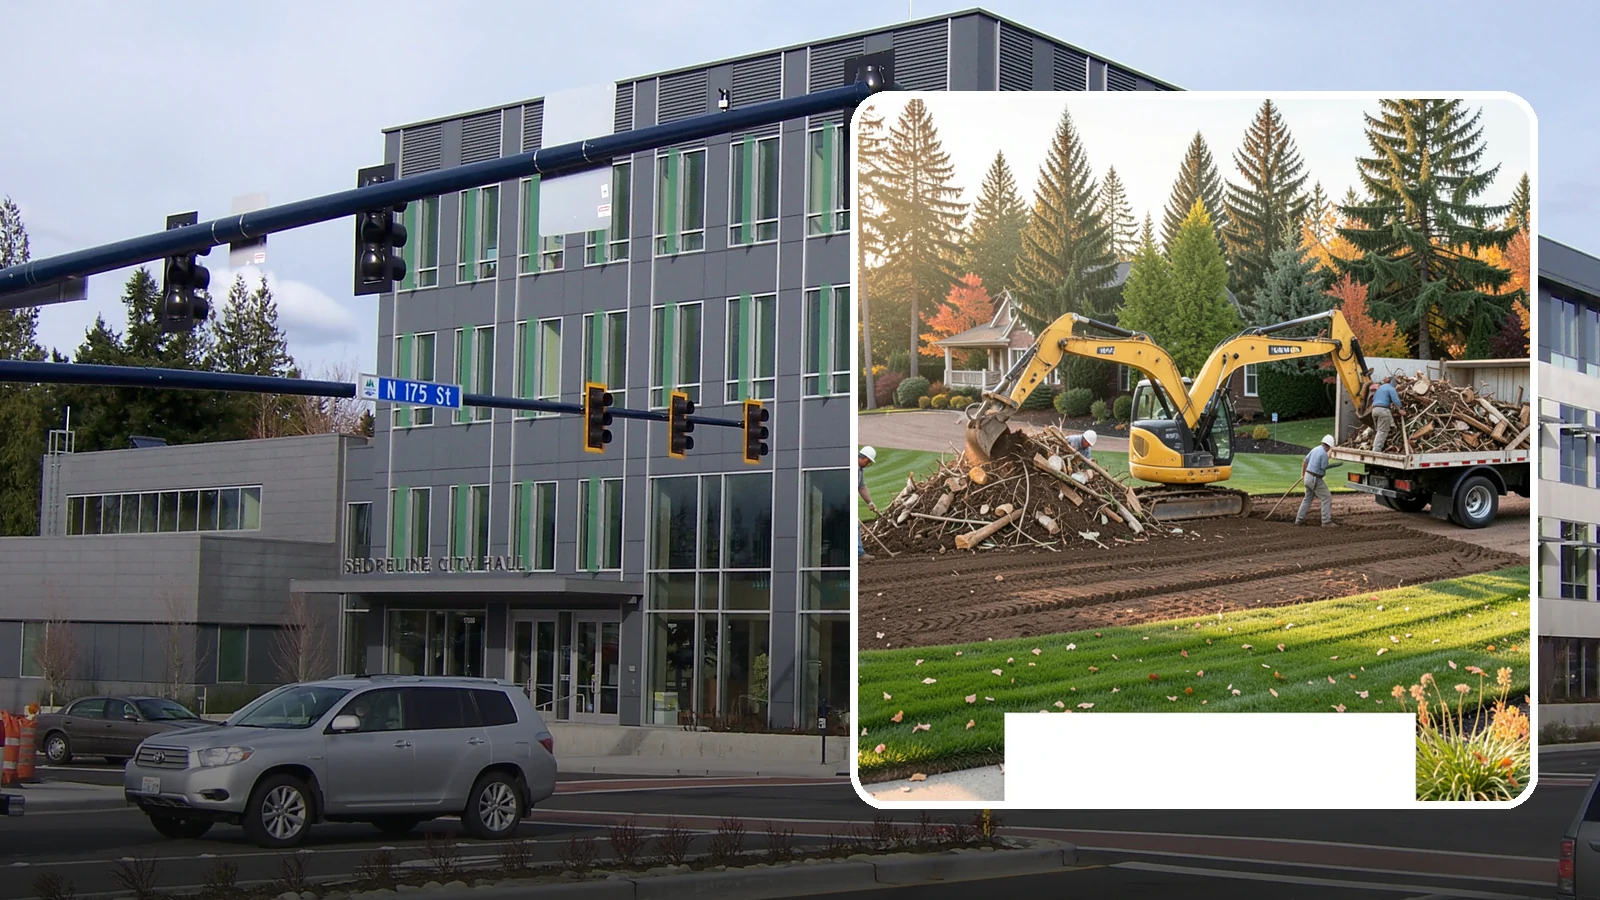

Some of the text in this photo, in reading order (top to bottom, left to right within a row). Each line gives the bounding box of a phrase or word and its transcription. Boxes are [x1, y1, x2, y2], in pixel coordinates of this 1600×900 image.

[387, 380, 451, 406] N 175 St
[344, 555, 525, 574] SHORELINE CITY HALL
